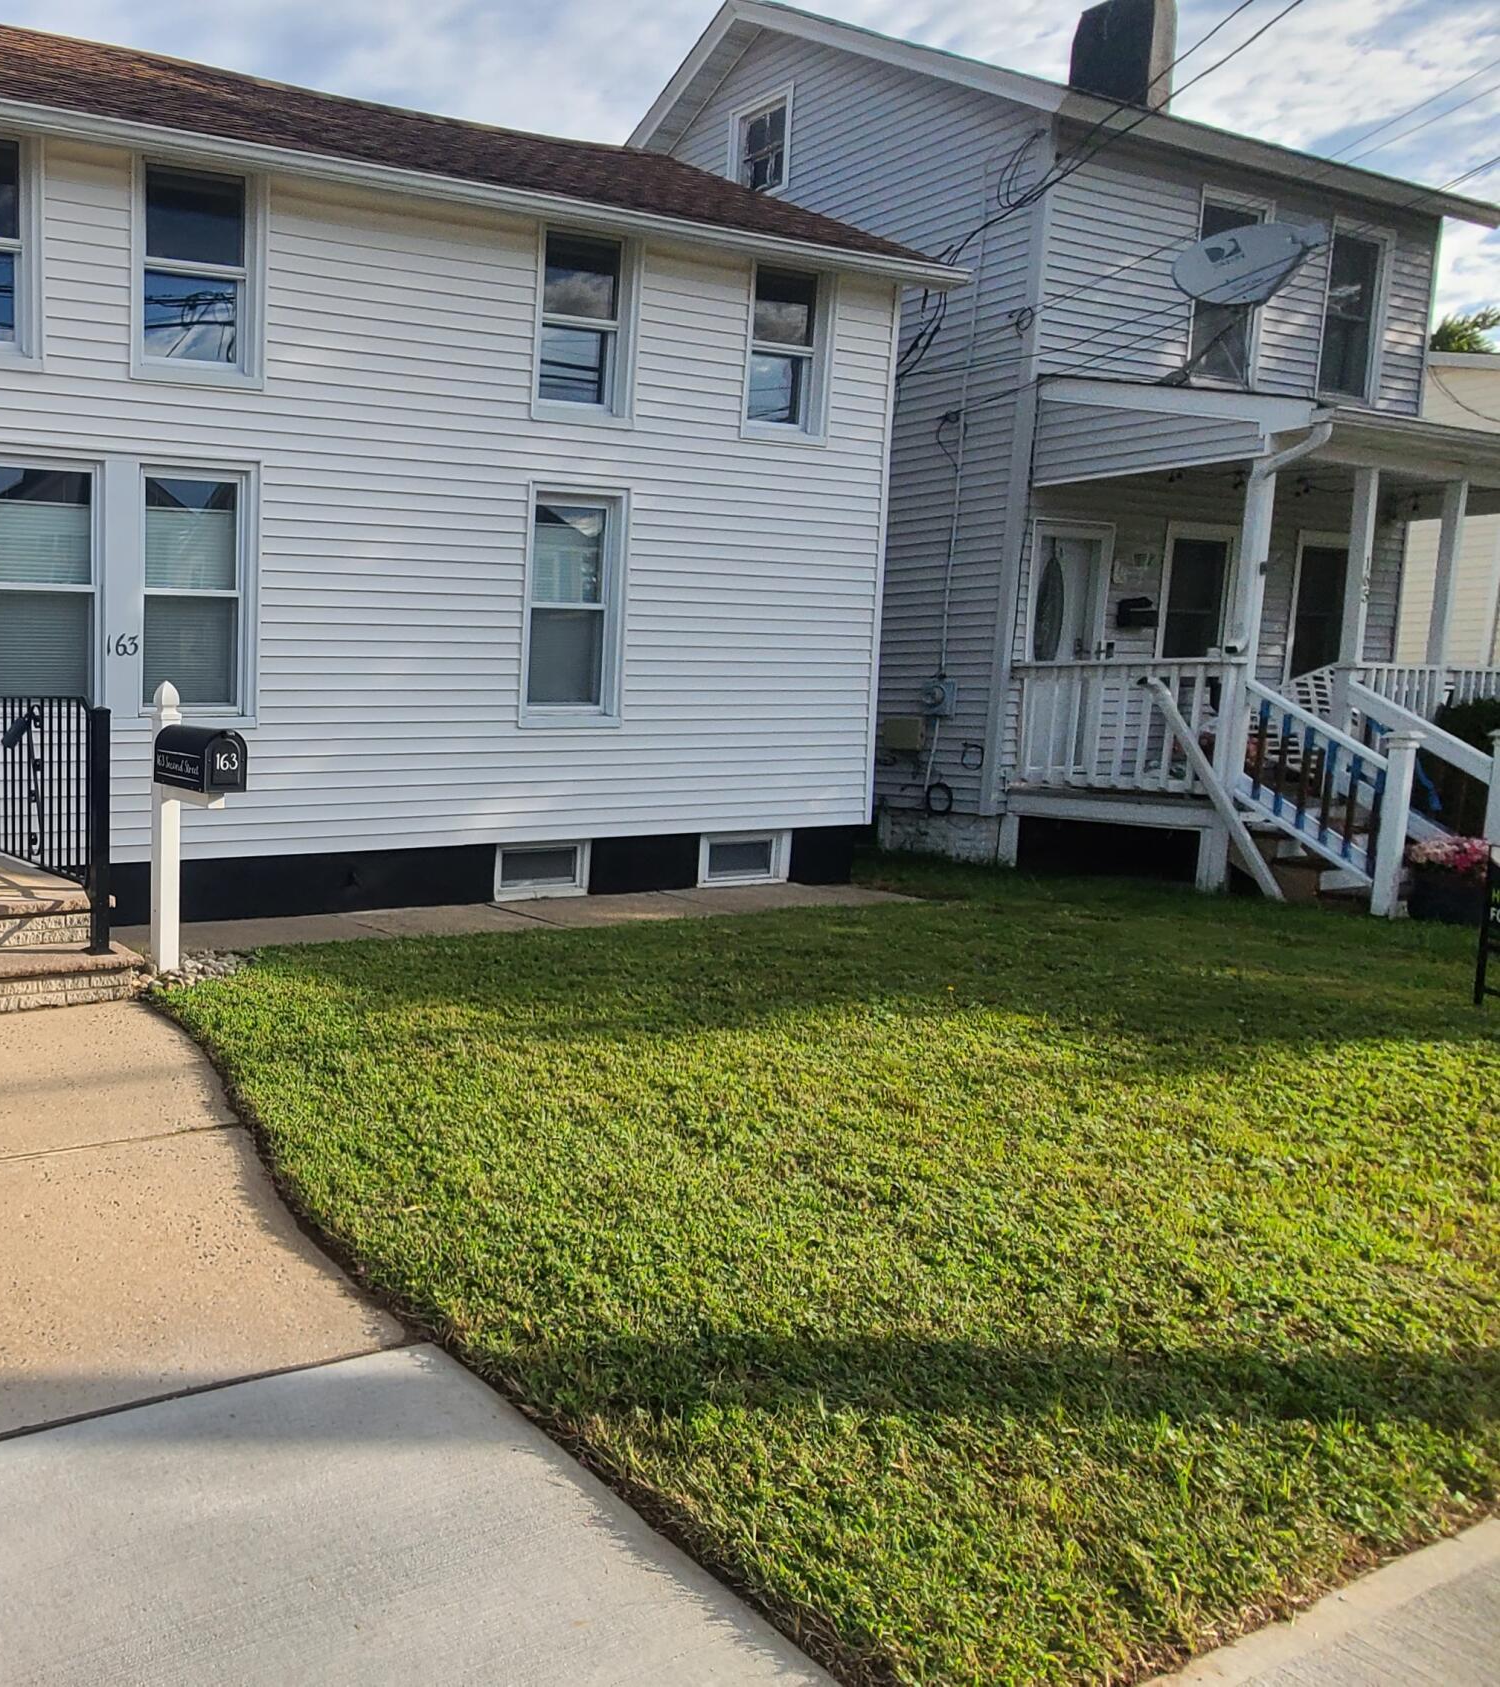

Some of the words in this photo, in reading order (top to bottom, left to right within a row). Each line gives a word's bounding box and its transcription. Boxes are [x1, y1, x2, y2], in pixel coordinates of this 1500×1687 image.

[106, 632, 139, 657] 163
[165, 756, 184, 772] Second
[184, 760, 200, 776] Street
[215, 752, 239, 771] 163
